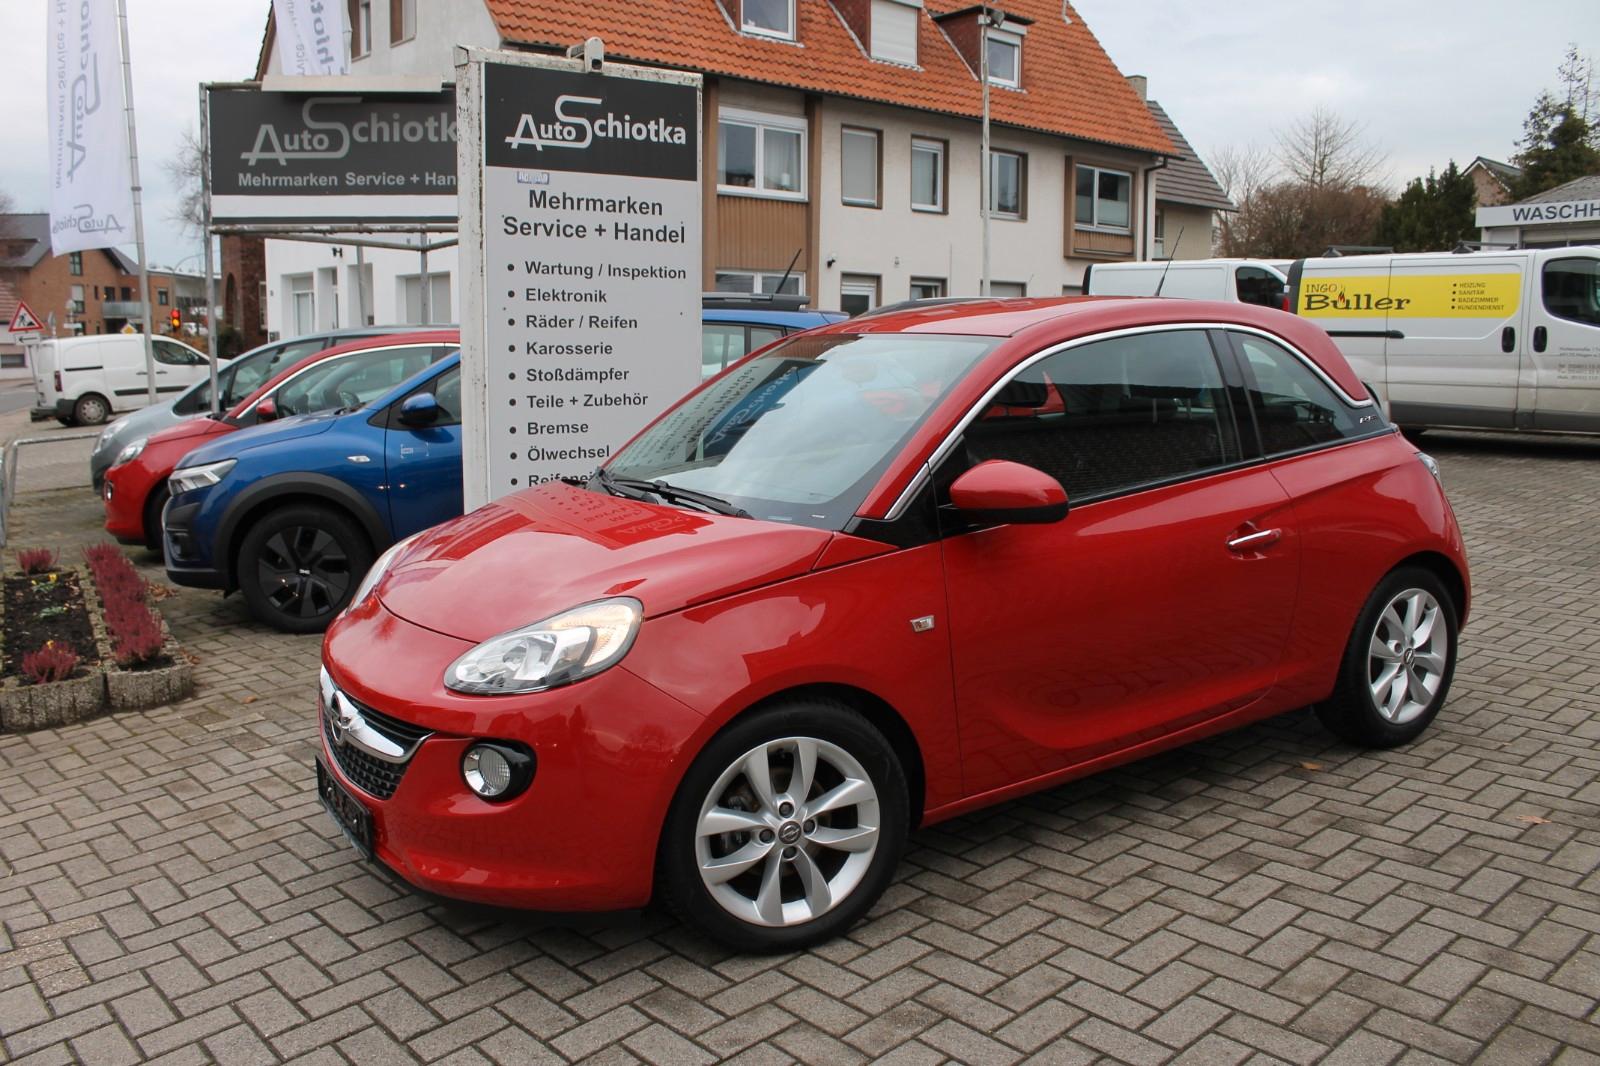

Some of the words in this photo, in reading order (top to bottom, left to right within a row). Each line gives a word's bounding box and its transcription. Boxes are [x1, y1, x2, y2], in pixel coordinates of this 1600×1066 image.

[238, 172, 338, 186] Mehrmarken
[345, 171, 405, 186] Service
[410, 174, 420, 184] +
[529, 189, 664, 216] Mehrmarken
[503, 215, 587, 239] Service
[595, 224, 607, 236] +
[614, 221, 686, 244] Handel
[525, 260, 594, 279] Wartung
[608, 263, 687, 280] Inspektion
[525, 288, 607, 303] Elektronik
[1306, 283, 1338, 293] INGO
[526, 314, 574, 329] Räder
[588, 315, 638, 329] Reifen
[526, 341, 613, 355] Karosserie
[526, 368, 630, 384] Stoßdämpfer
[526, 394, 564, 408] Teile
[583, 392, 648, 407] Zubehör
[527, 421, 589, 435] Bremse
[527, 445, 610, 462] Ölwechsel
